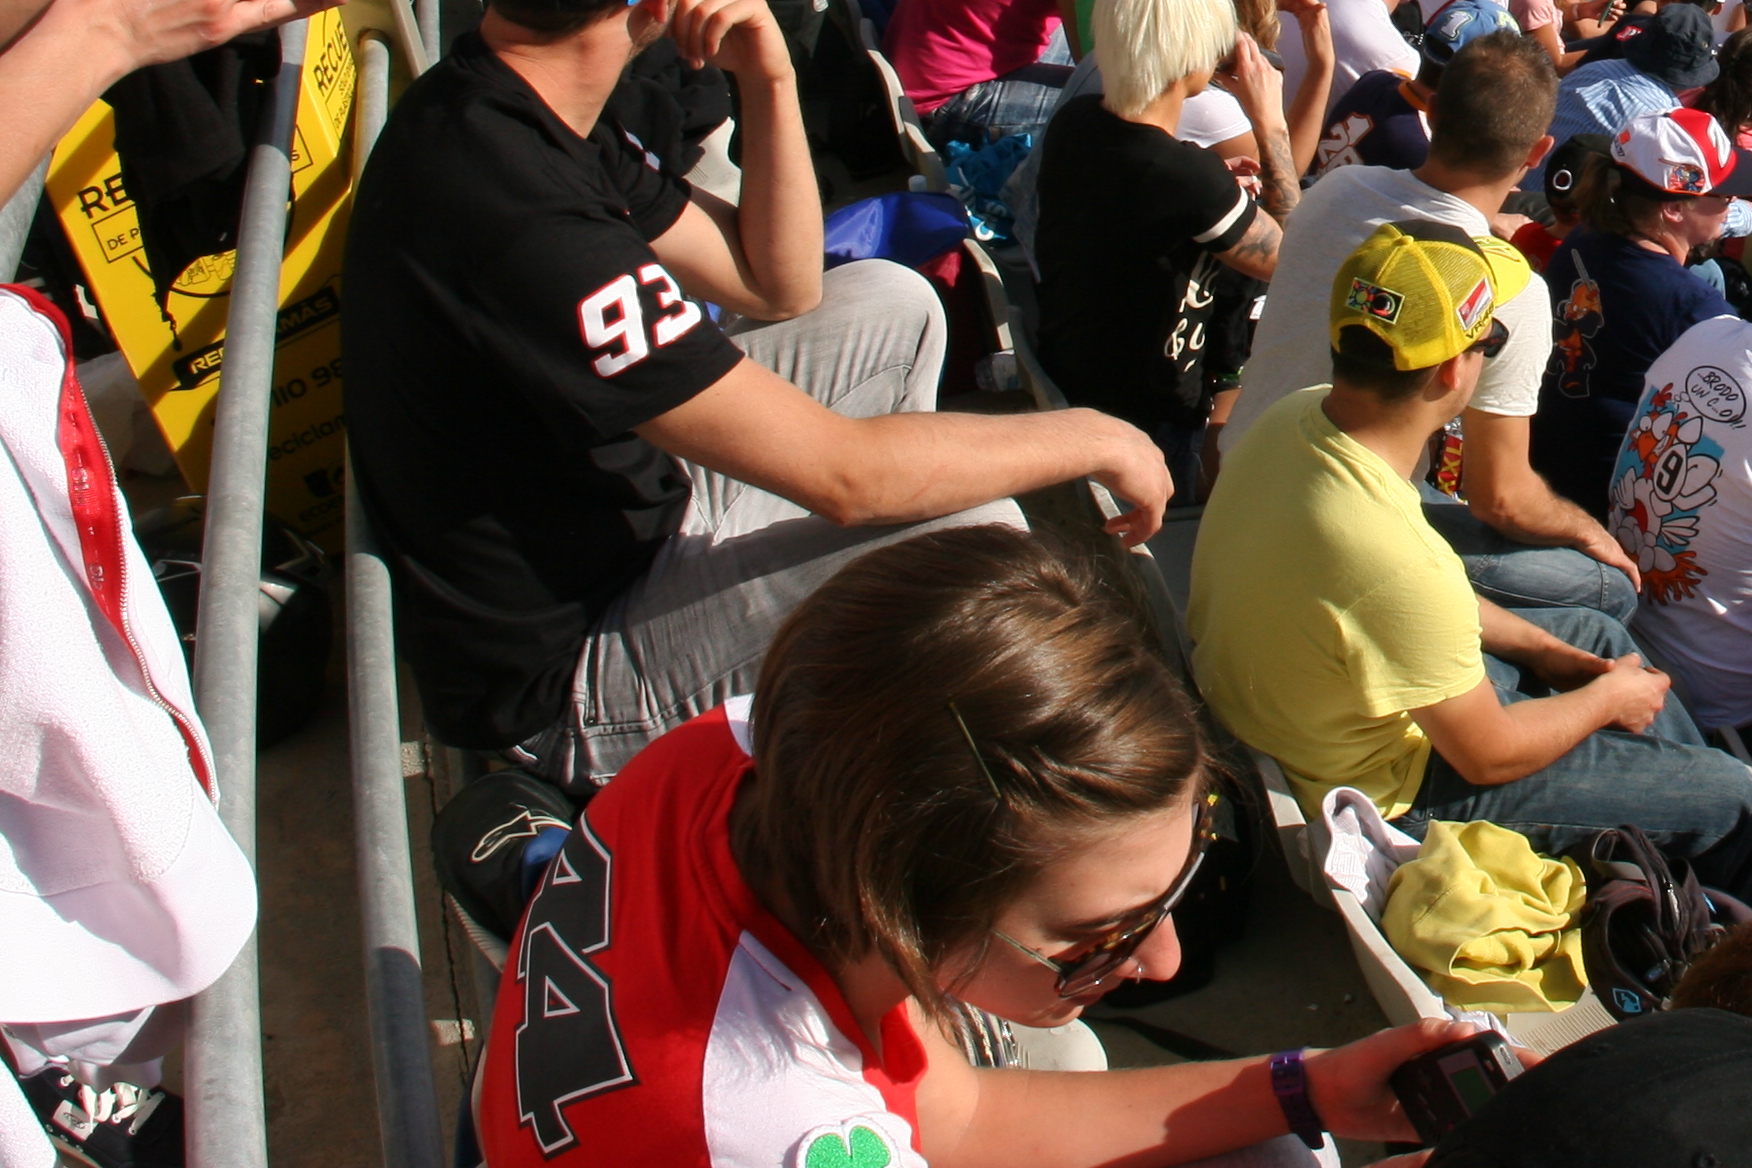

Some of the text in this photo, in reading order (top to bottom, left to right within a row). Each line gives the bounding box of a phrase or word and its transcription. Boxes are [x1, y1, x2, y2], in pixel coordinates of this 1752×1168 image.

[107, 234, 127, 250] DE
[579, 262, 702, 378] 93
[1691, 384, 1710, 399] UN
[1438, 442, 1464, 497] XXL
[1656, 449, 1683, 495] 9
